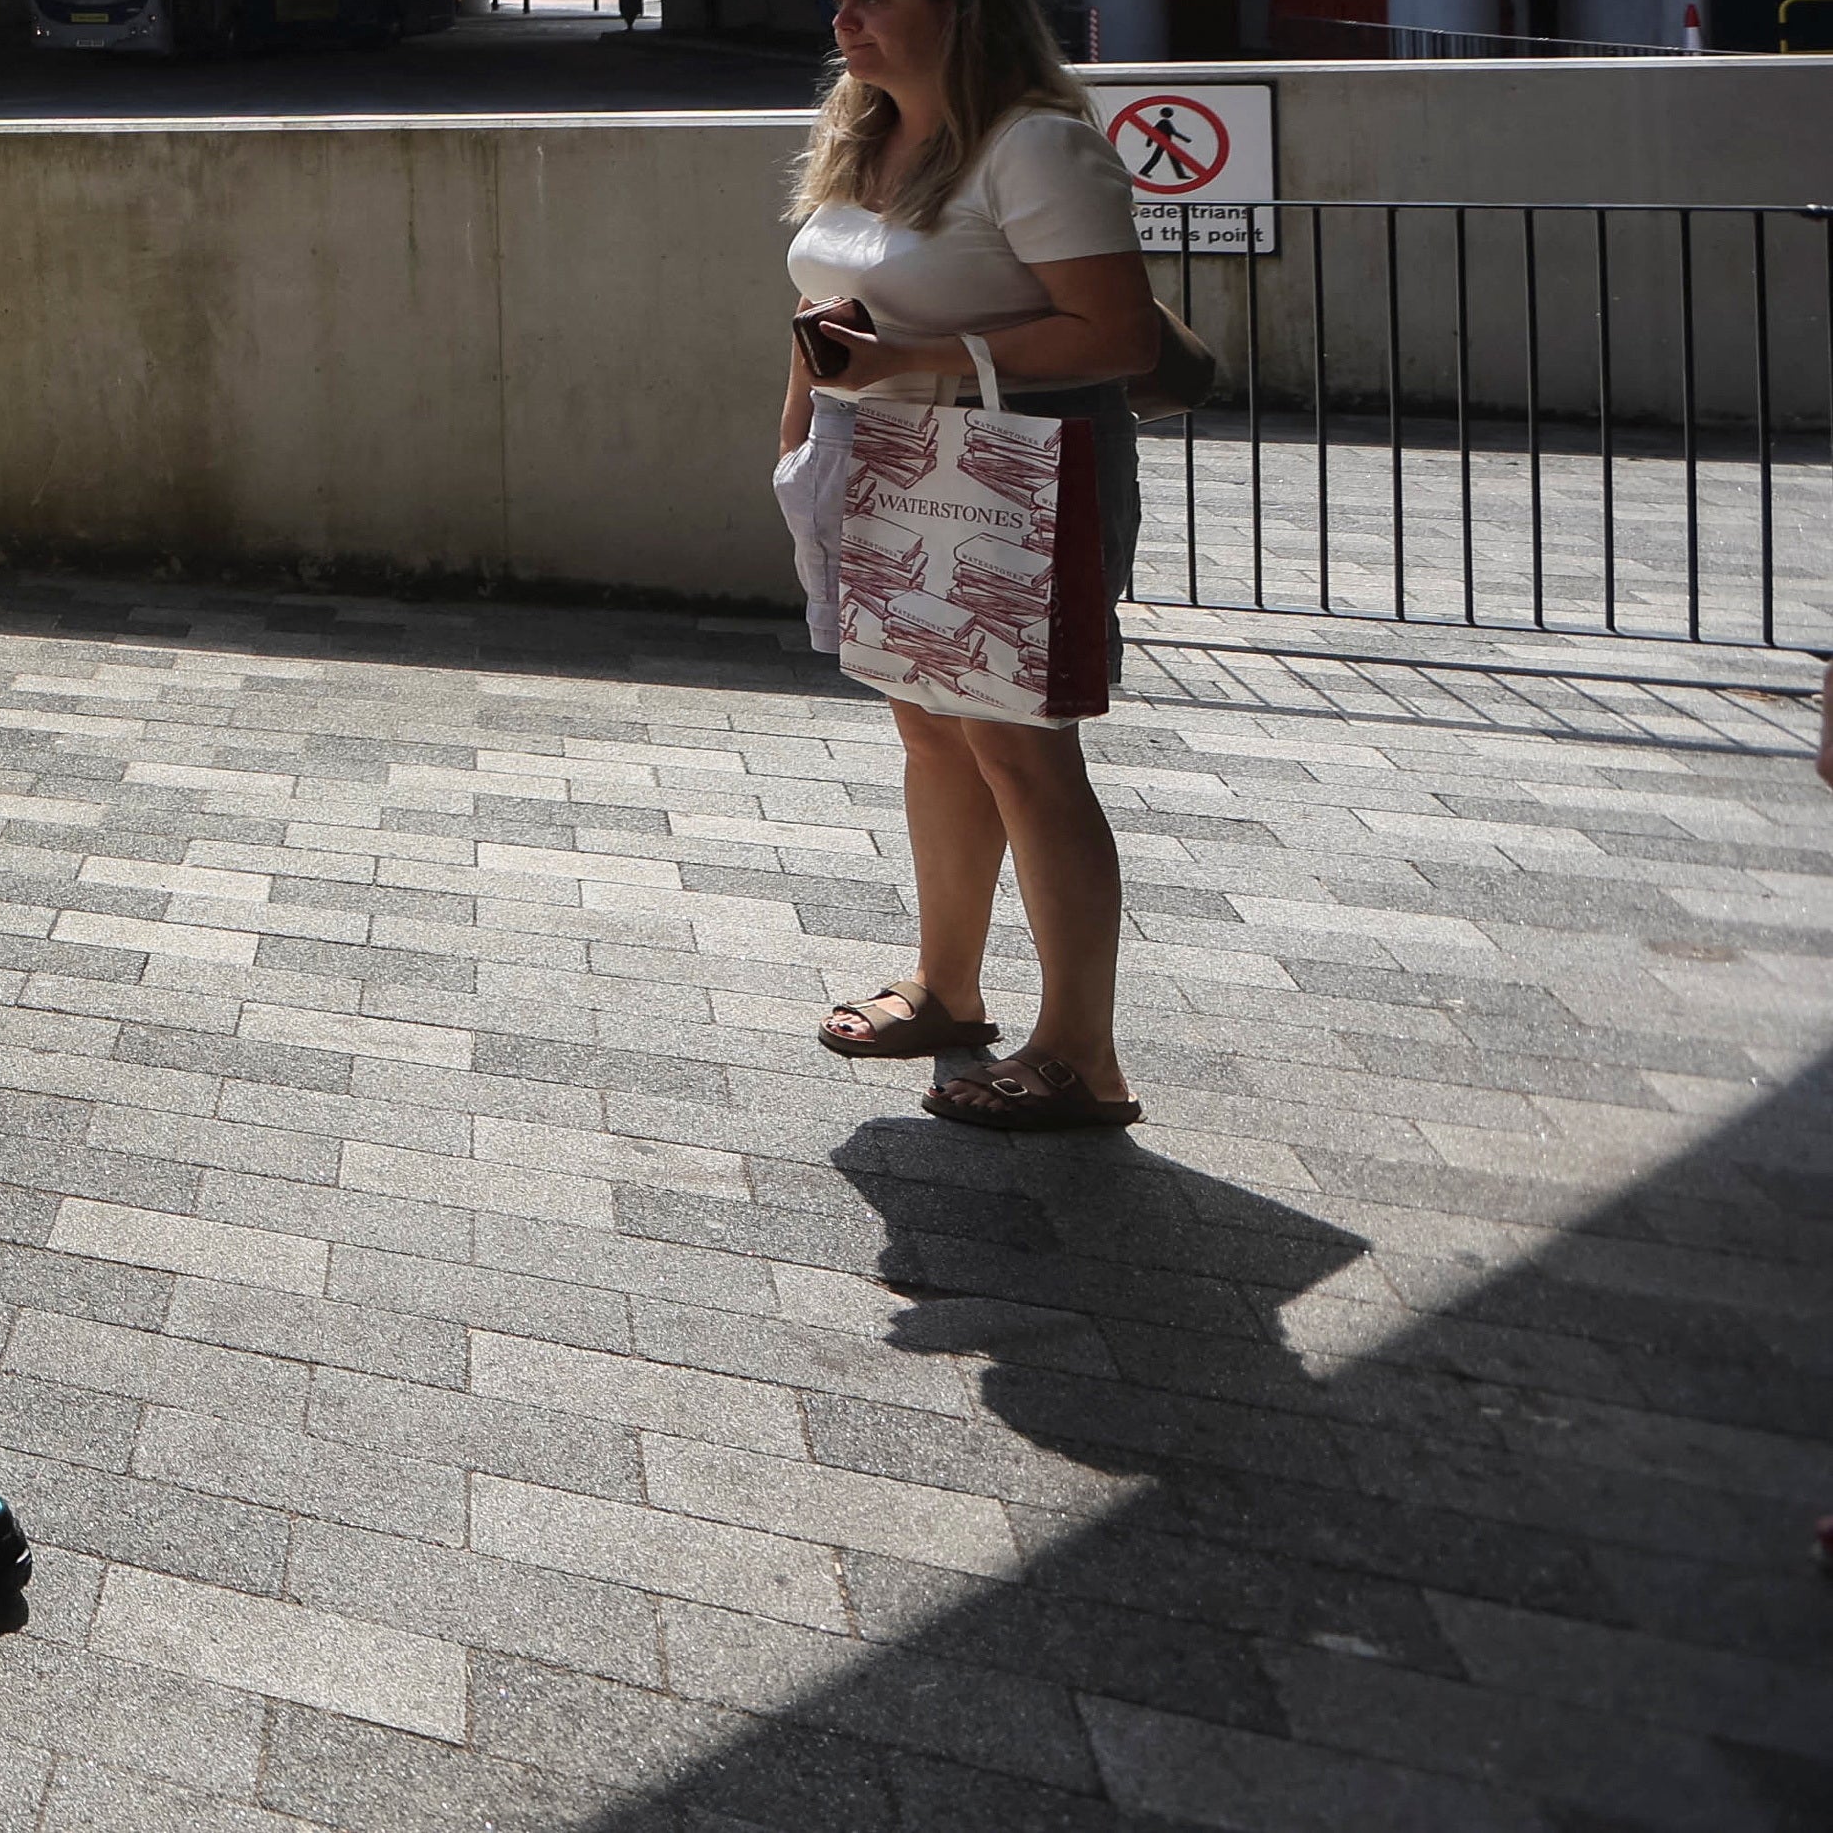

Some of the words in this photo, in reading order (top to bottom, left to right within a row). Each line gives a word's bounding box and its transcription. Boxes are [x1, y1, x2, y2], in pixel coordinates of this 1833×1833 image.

[1160, 225, 1200, 242] ths
[973, 419, 1040, 446] WATERSTONES
[878, 492, 1024, 529] WATERSTONES
[961, 553, 1026, 581] WATERSTONES
[891, 605, 947, 634] WATERSTONES
